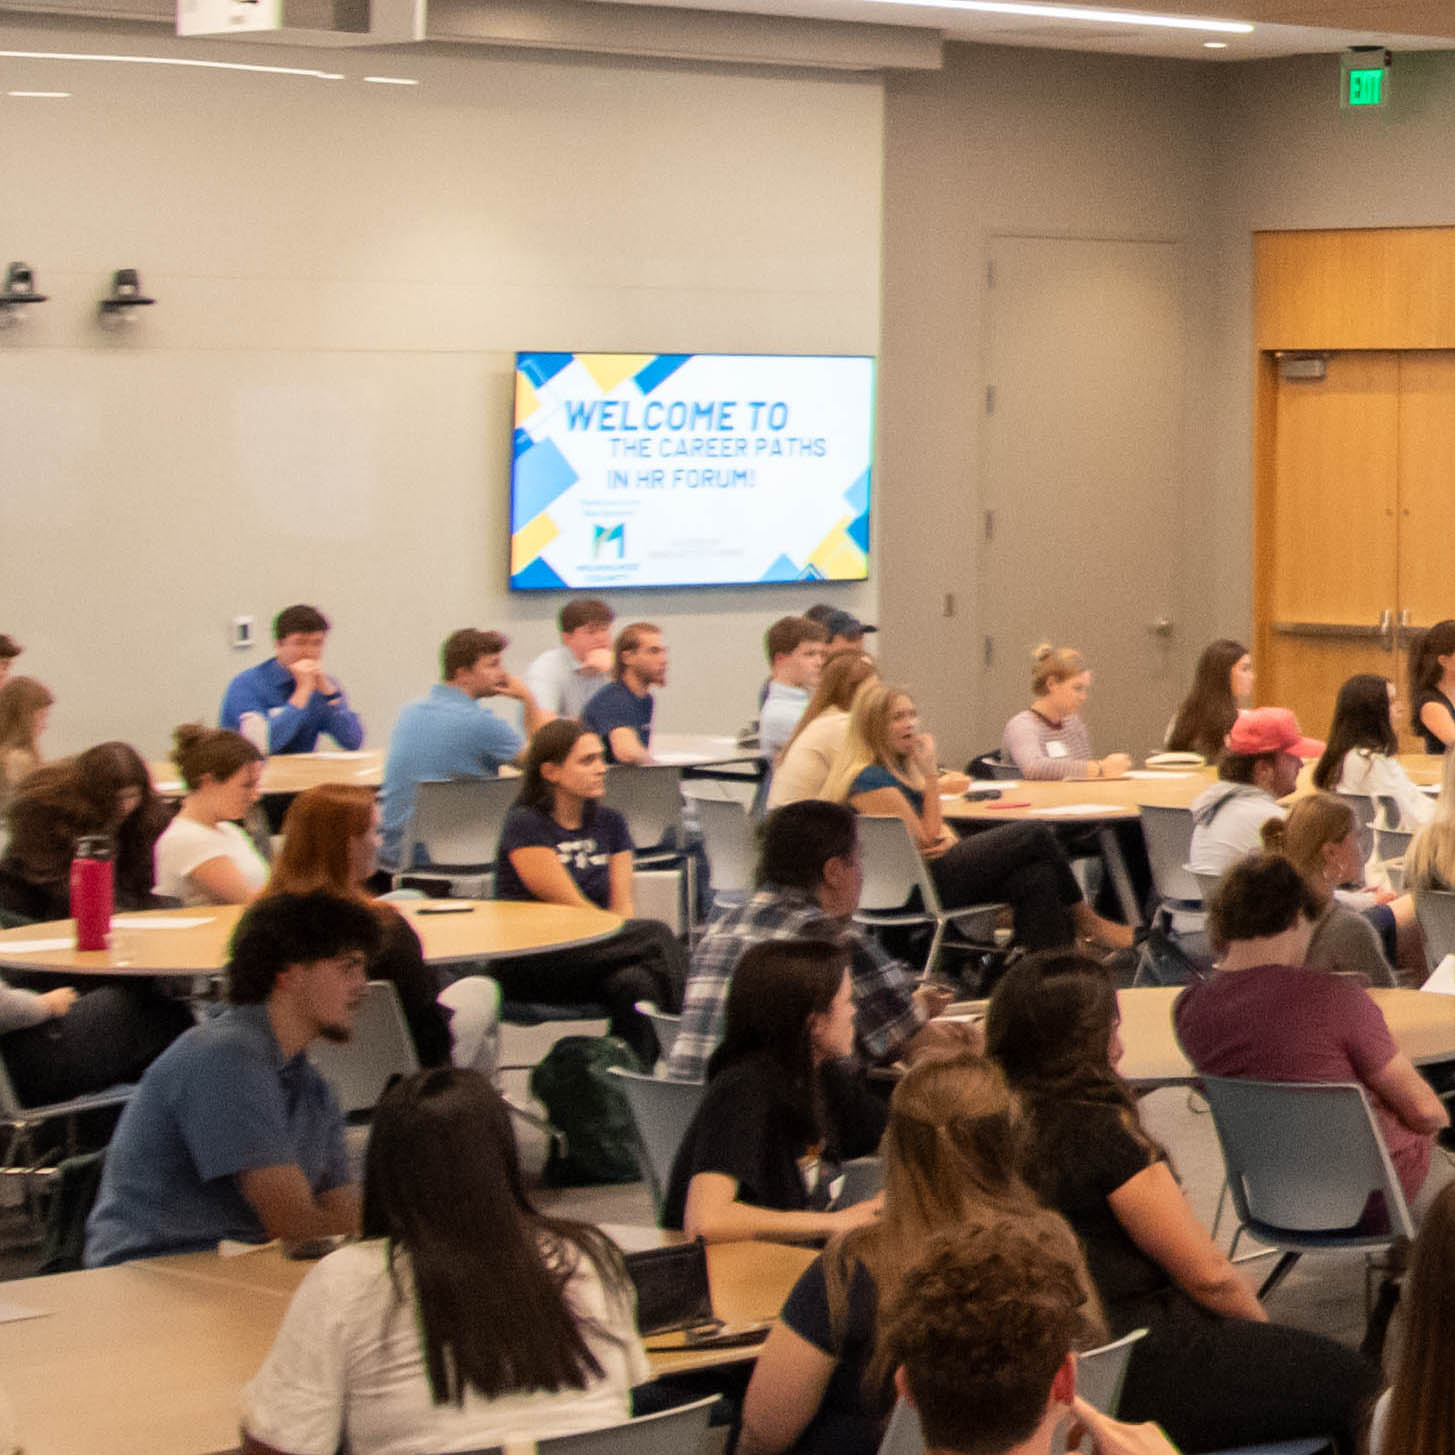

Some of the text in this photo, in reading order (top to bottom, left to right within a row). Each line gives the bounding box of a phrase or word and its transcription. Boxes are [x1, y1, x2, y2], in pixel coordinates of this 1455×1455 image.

[565, 400, 789, 432] WELCOME TO
[609, 437, 827, 458] THE CAREER PATHS
[608, 468, 757, 489] IN HR FORUM!
